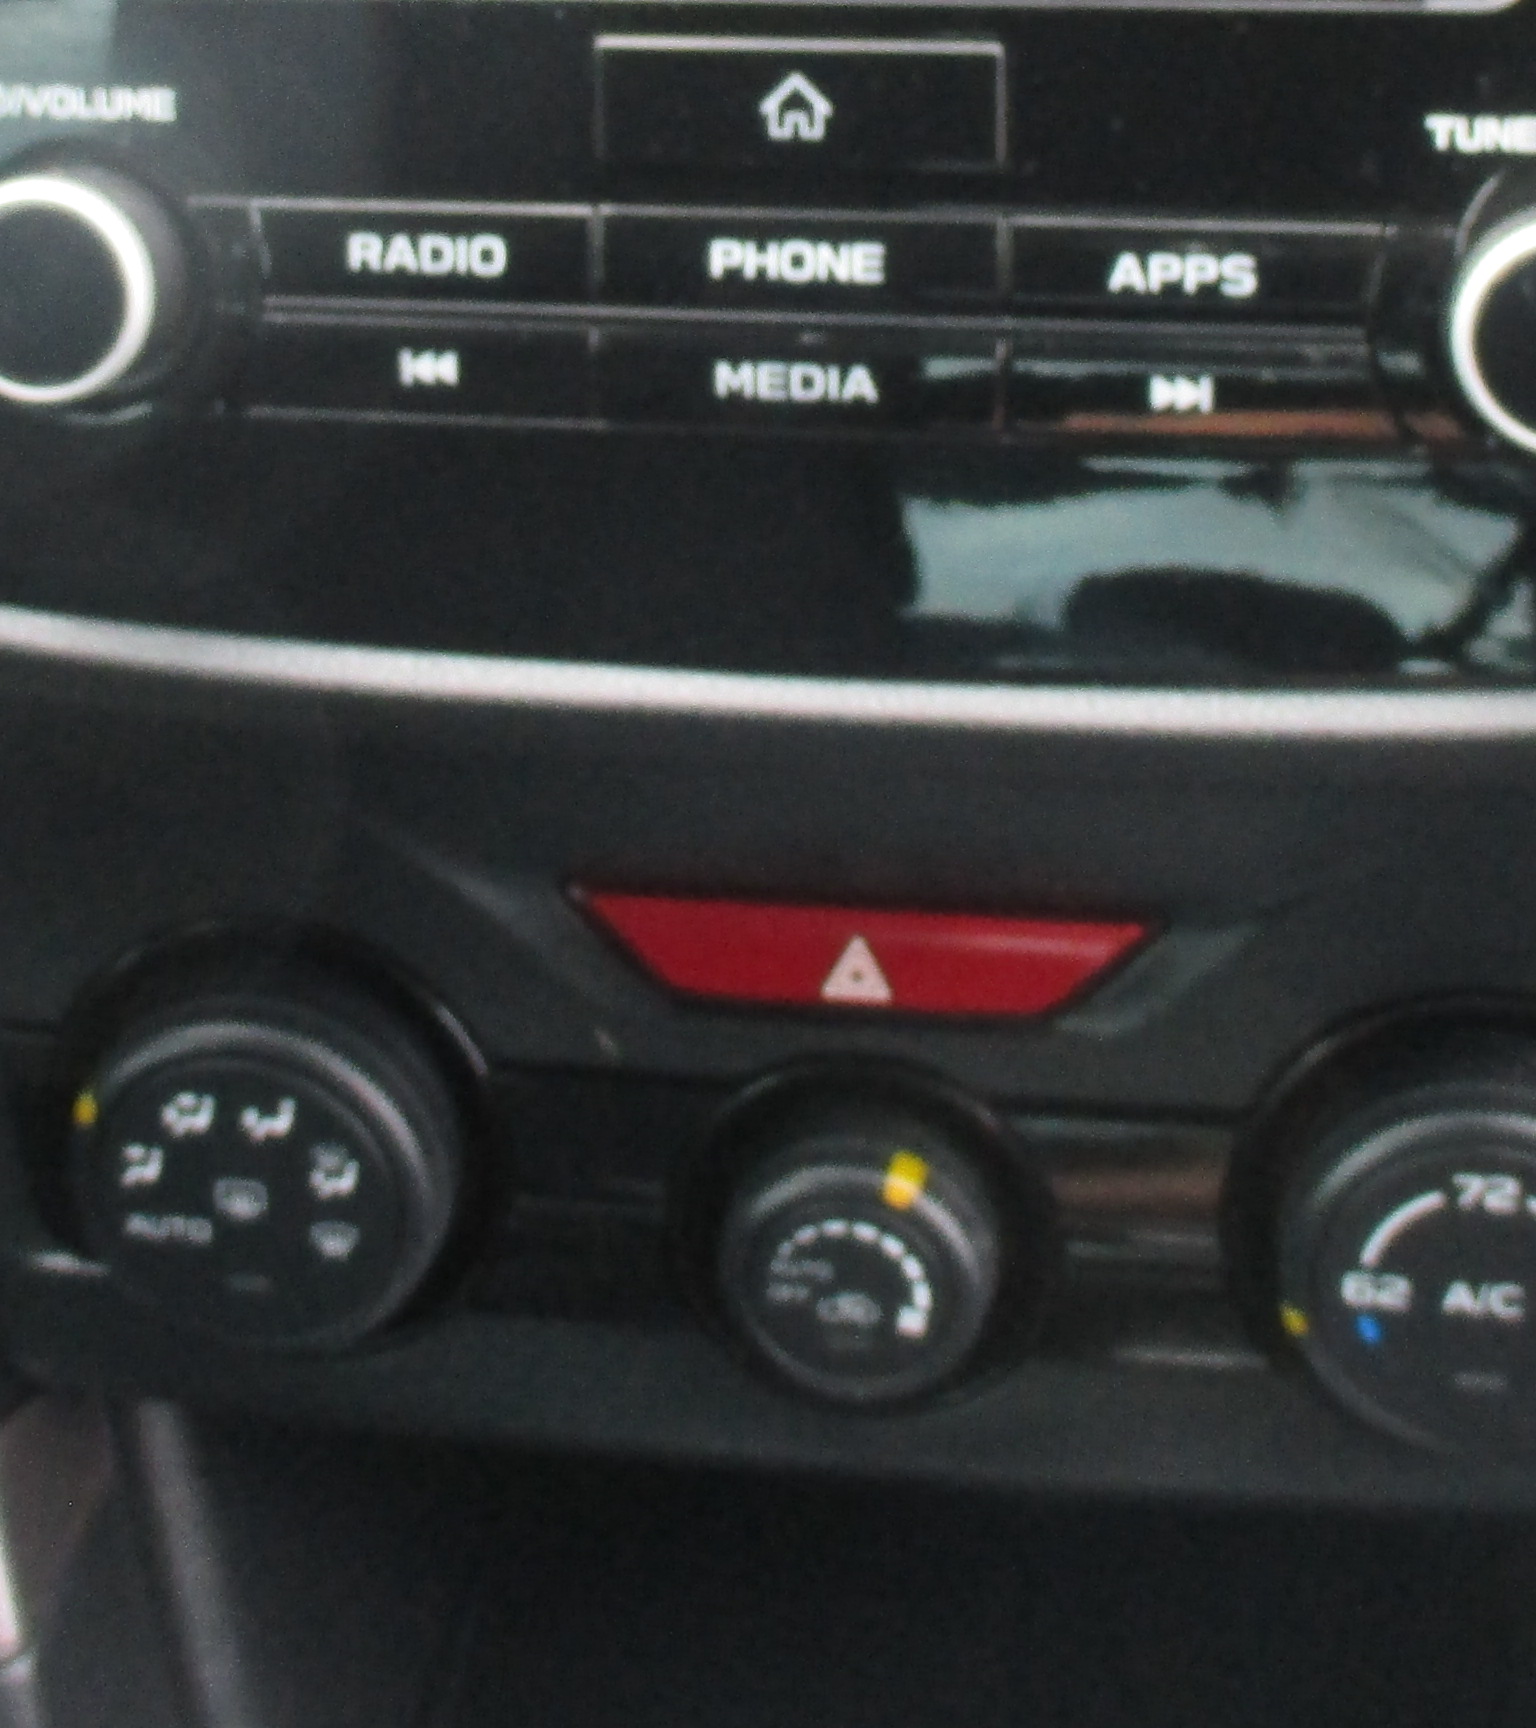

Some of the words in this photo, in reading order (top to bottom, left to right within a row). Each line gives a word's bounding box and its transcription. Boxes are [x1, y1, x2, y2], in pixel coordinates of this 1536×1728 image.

[347, 231, 508, 278] RADIO
[708, 237, 887, 286] PHONE
[1107, 250, 1259, 299] APPS
[714, 358, 880, 405] MEDIA
[1451, 1172, 1523, 1216] 72
[1441, 1280, 1526, 1321] A/C
